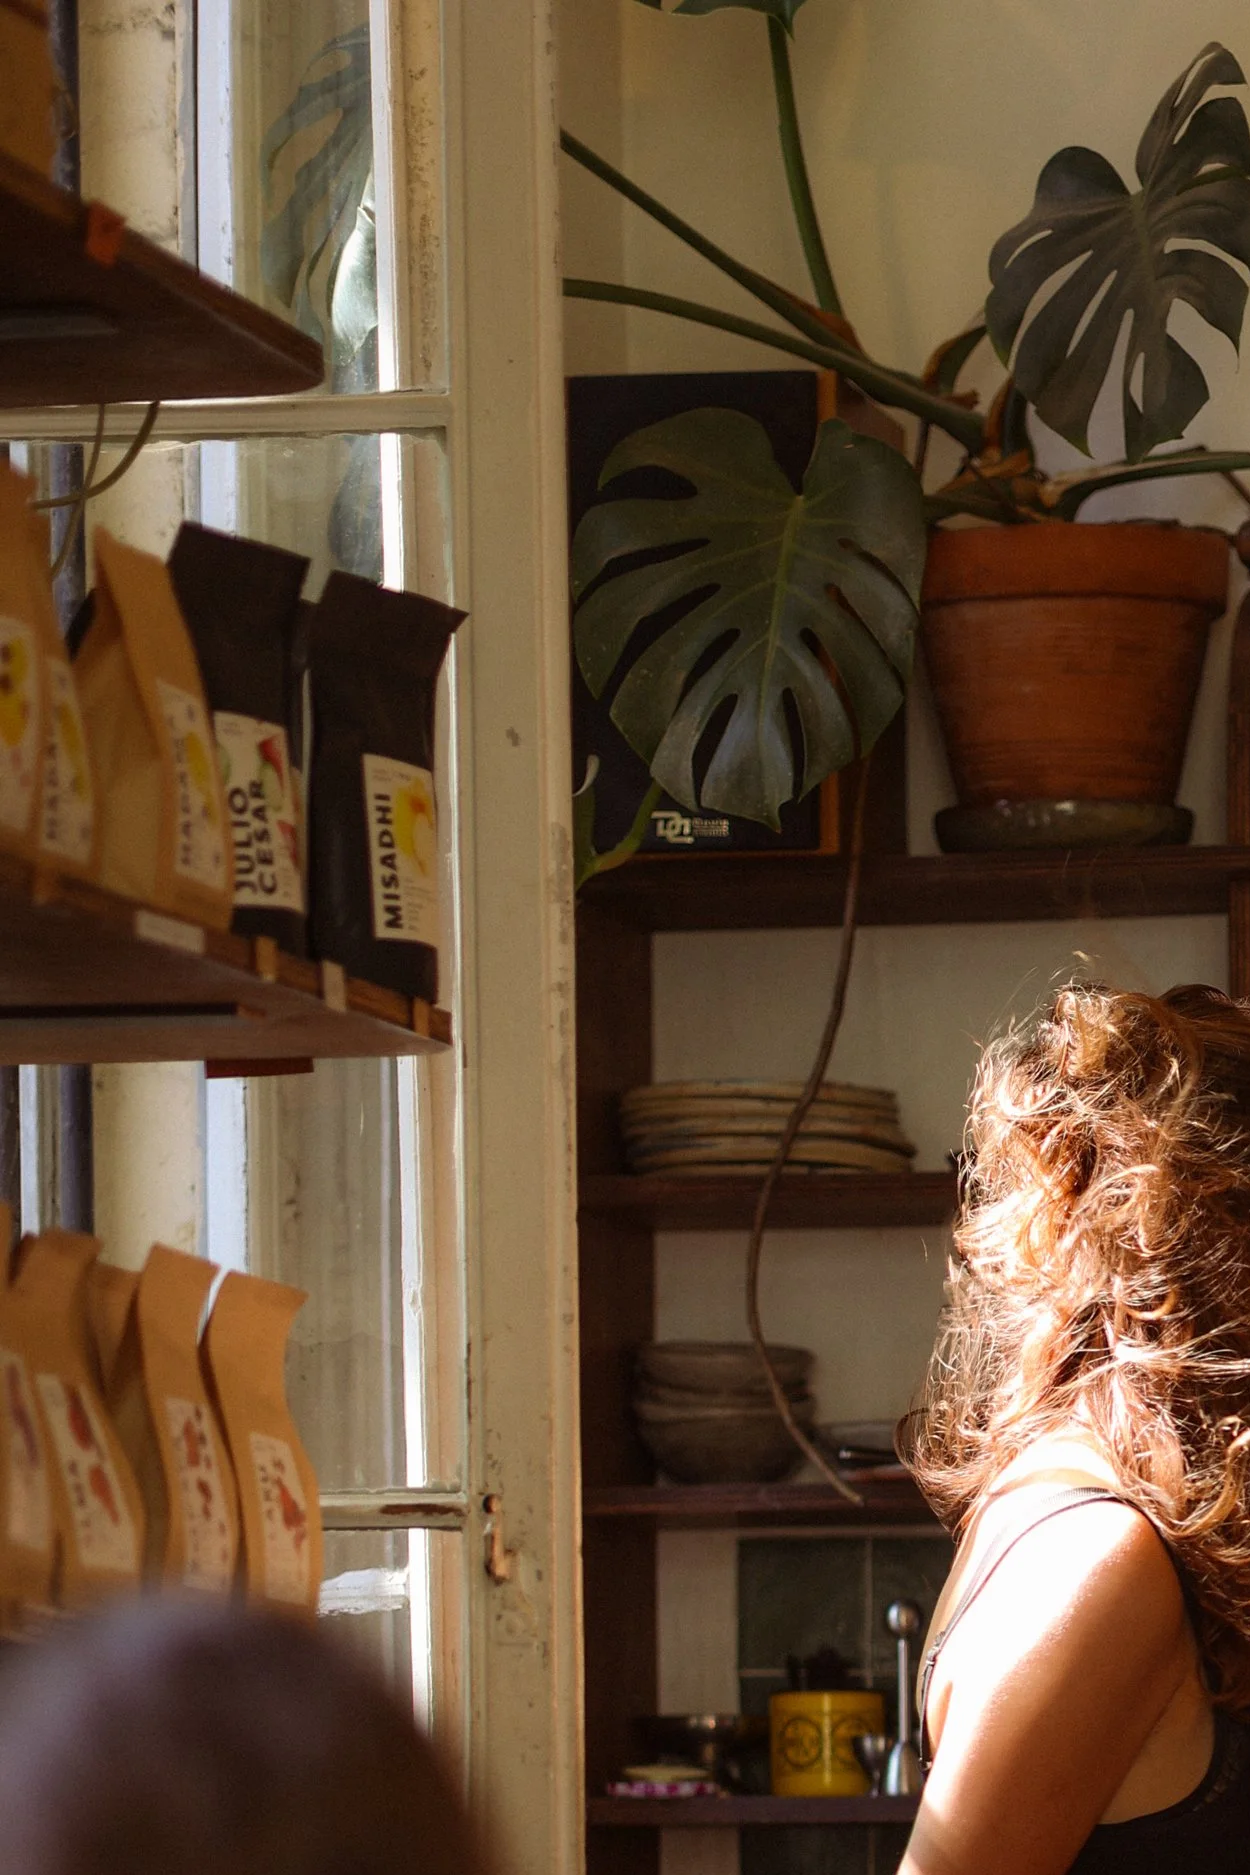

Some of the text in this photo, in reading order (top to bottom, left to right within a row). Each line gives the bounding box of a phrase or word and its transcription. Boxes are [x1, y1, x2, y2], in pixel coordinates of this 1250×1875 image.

[228, 787, 257, 895] JULIO
[249, 779, 278, 895] CESAR
[373, 792, 404, 930] MISADHI
